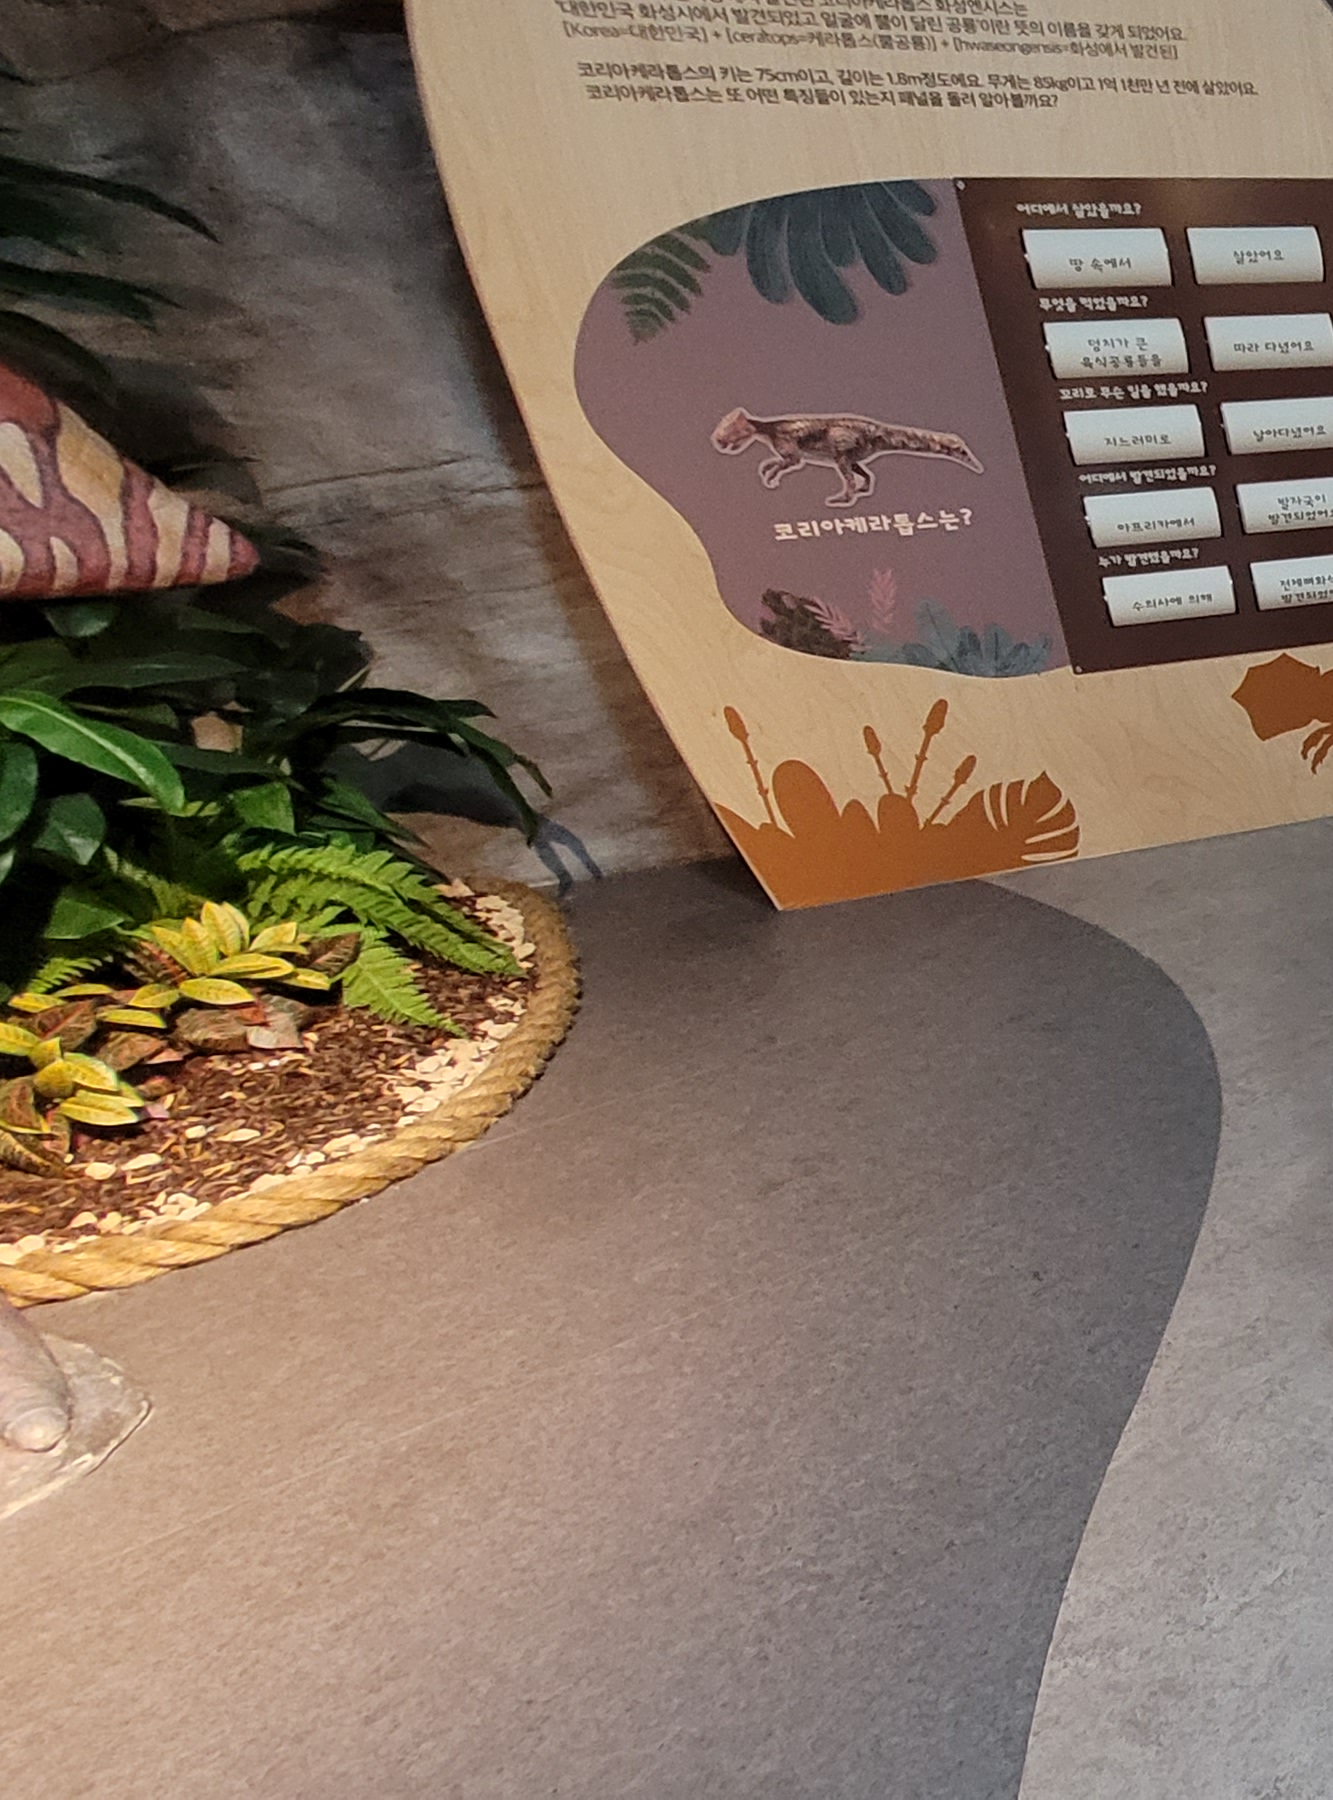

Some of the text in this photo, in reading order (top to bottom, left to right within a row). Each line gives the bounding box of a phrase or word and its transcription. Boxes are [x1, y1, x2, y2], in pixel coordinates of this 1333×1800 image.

[638, 3, 729, 24] 화성시에서
[730, 7, 819, 27] 발견되었고
[820, 11, 872, 29] 얼굴에
[874, 14, 907, 31] 뿔이
[910, 15, 943, 33] 달린
[1013, 19, 1045, 36] 뜻의
[1047, 21, 1092, 38] 이름을
[1094, 23, 1125, 39] 갖게
[577, 62, 716, 81] 코리아케라톱스의
[719, 65, 753, 83] 키는
[836, 69, 885, 86] 길이는
[988, 74, 1031, 91] 무게는
[1155, 79, 1172, 94] 년
[1173, 79, 1200, 95] 전에
[586, 84, 724, 103] 코리아케라톱스는
[726, 87, 745, 103] 또
[746, 88, 780, 104] 어떤
[783, 88, 847, 106] 특징들이
[848, 90, 897, 106] 있는지
[898, 91, 943, 107] 패널을
[1015, 202, 1142, 219] 어디에서 살았을까요?
[1069, 257, 1132, 273] 땅 속에서
[1233, 249, 1285, 265] 살았어요
[1039, 295, 1149, 313] 무엇을 먹었을까요?
[1087, 337, 1149, 352] 덩치가 큰
[1233, 340, 1316, 354] 따라 다녔어요
[1080, 353, 1163, 370] 육식공룡들을
[1059, 381, 1209, 400] 꼬리로 무슨 일을 했을까요?
[1104, 433, 1172, 447] 지느러미로
[1253, 424, 1327, 443] 날아다녔어요
[1078, 465, 1217, 485] 어디에서 발견되었을까요?
[1277, 493, 1327, 510] 발자국이
[774, 507, 974, 541] 코리아케라톱스는?
[1117, 517, 1196, 533] 아프리카에서
[1098, 548, 1200, 568] 누가 발견했을까요?
[1132, 593, 1213, 612] 수의사에 의해
